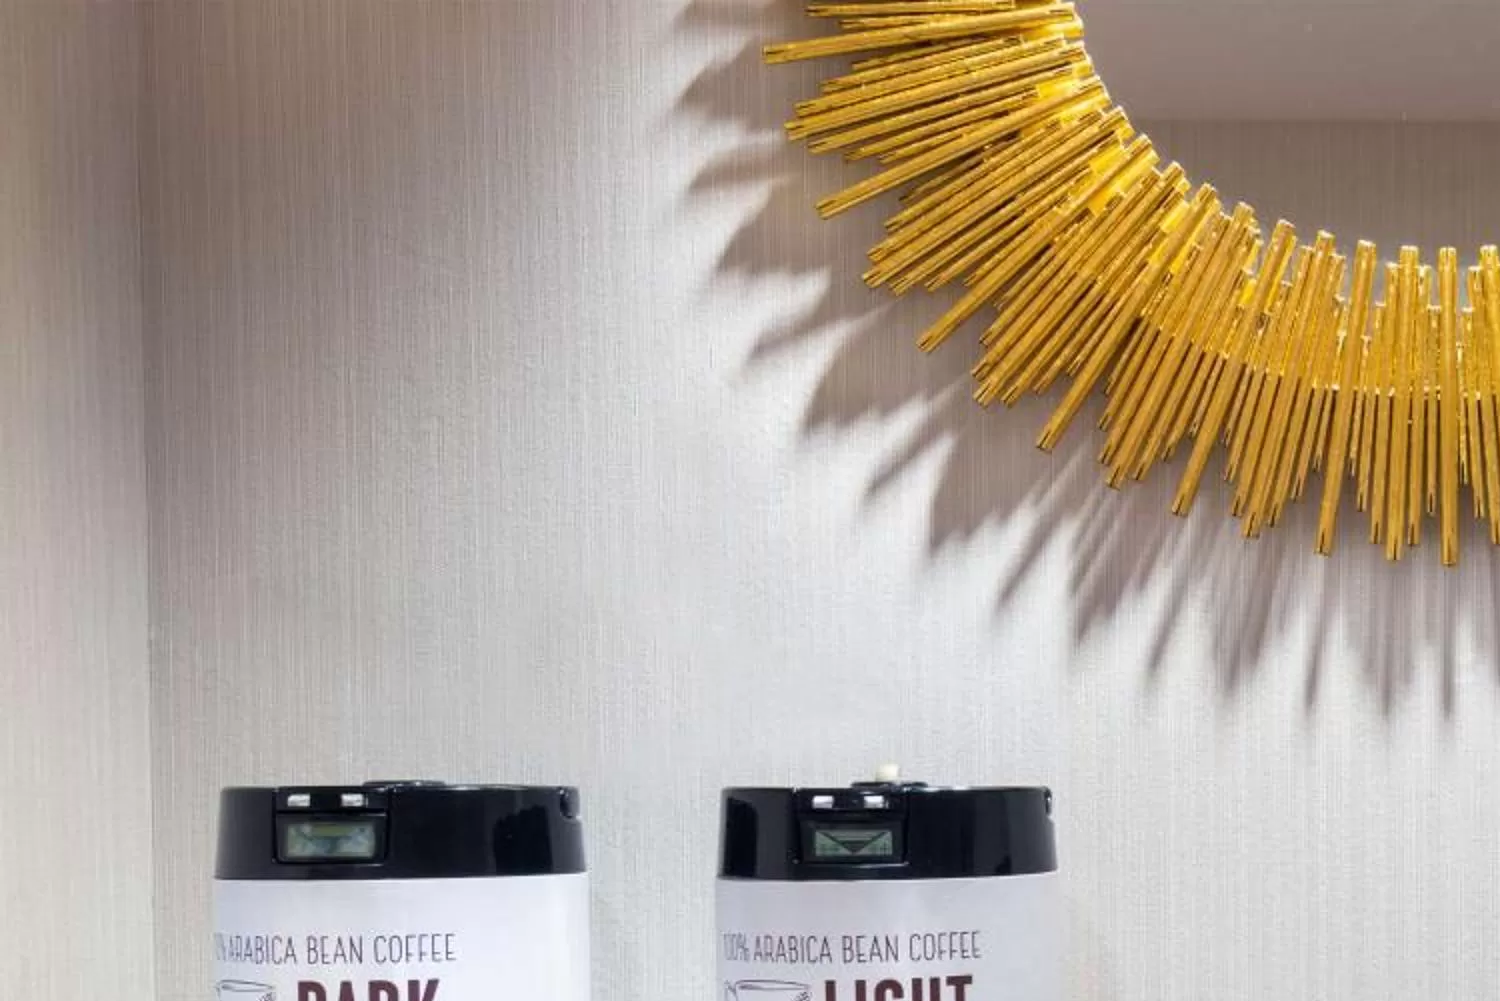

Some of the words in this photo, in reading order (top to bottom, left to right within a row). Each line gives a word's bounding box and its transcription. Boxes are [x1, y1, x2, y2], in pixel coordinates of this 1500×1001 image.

[306, 935, 365, 965] BEAN
[373, 933, 457, 964] COFFEE
[753, 935, 833, 964] ARABICA
[841, 933, 899, 964] BEAN
[908, 930, 982, 961] COFFEE
